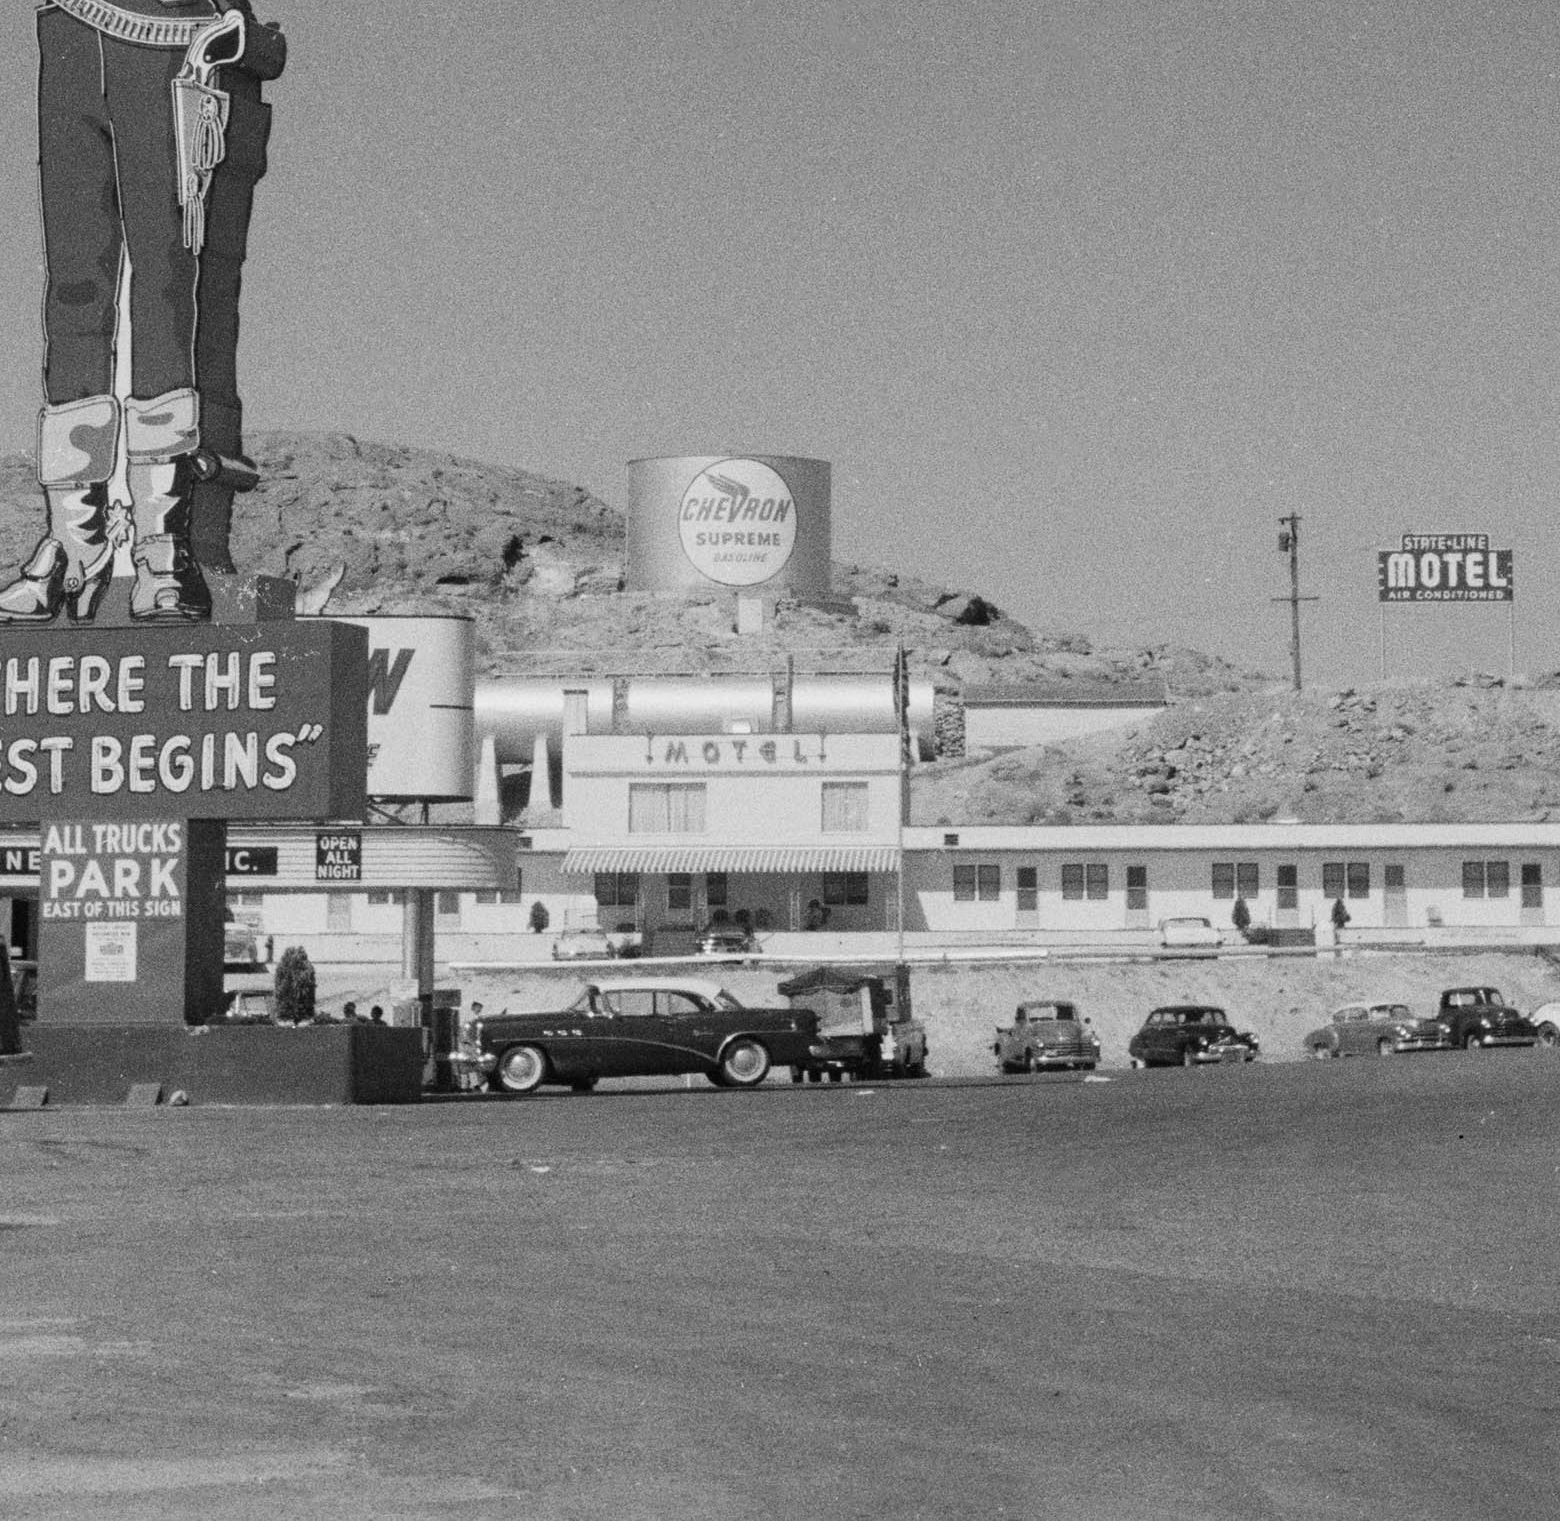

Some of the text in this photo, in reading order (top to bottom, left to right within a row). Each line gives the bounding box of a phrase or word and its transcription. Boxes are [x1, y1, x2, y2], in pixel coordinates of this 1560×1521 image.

[682, 497, 793, 523] CHEVRON
[695, 531, 781, 546] SUPREME
[1387, 552, 1507, 588] MOTEL
[1388, 590, 1505, 600] AIR CONDITIONED
[168, 651, 277, 712] THE
[664, 740, 809, 765] MOTEL
[43, 822, 183, 855] ALL TRUCKS
[320, 836, 358, 851] OPEN
[325, 851, 352, 865] ALL
[50, 857, 180, 899] PARK
[317, 864, 360, 879] NIGHT
[43, 900, 182, 918] EAST OF THIS SIGN
